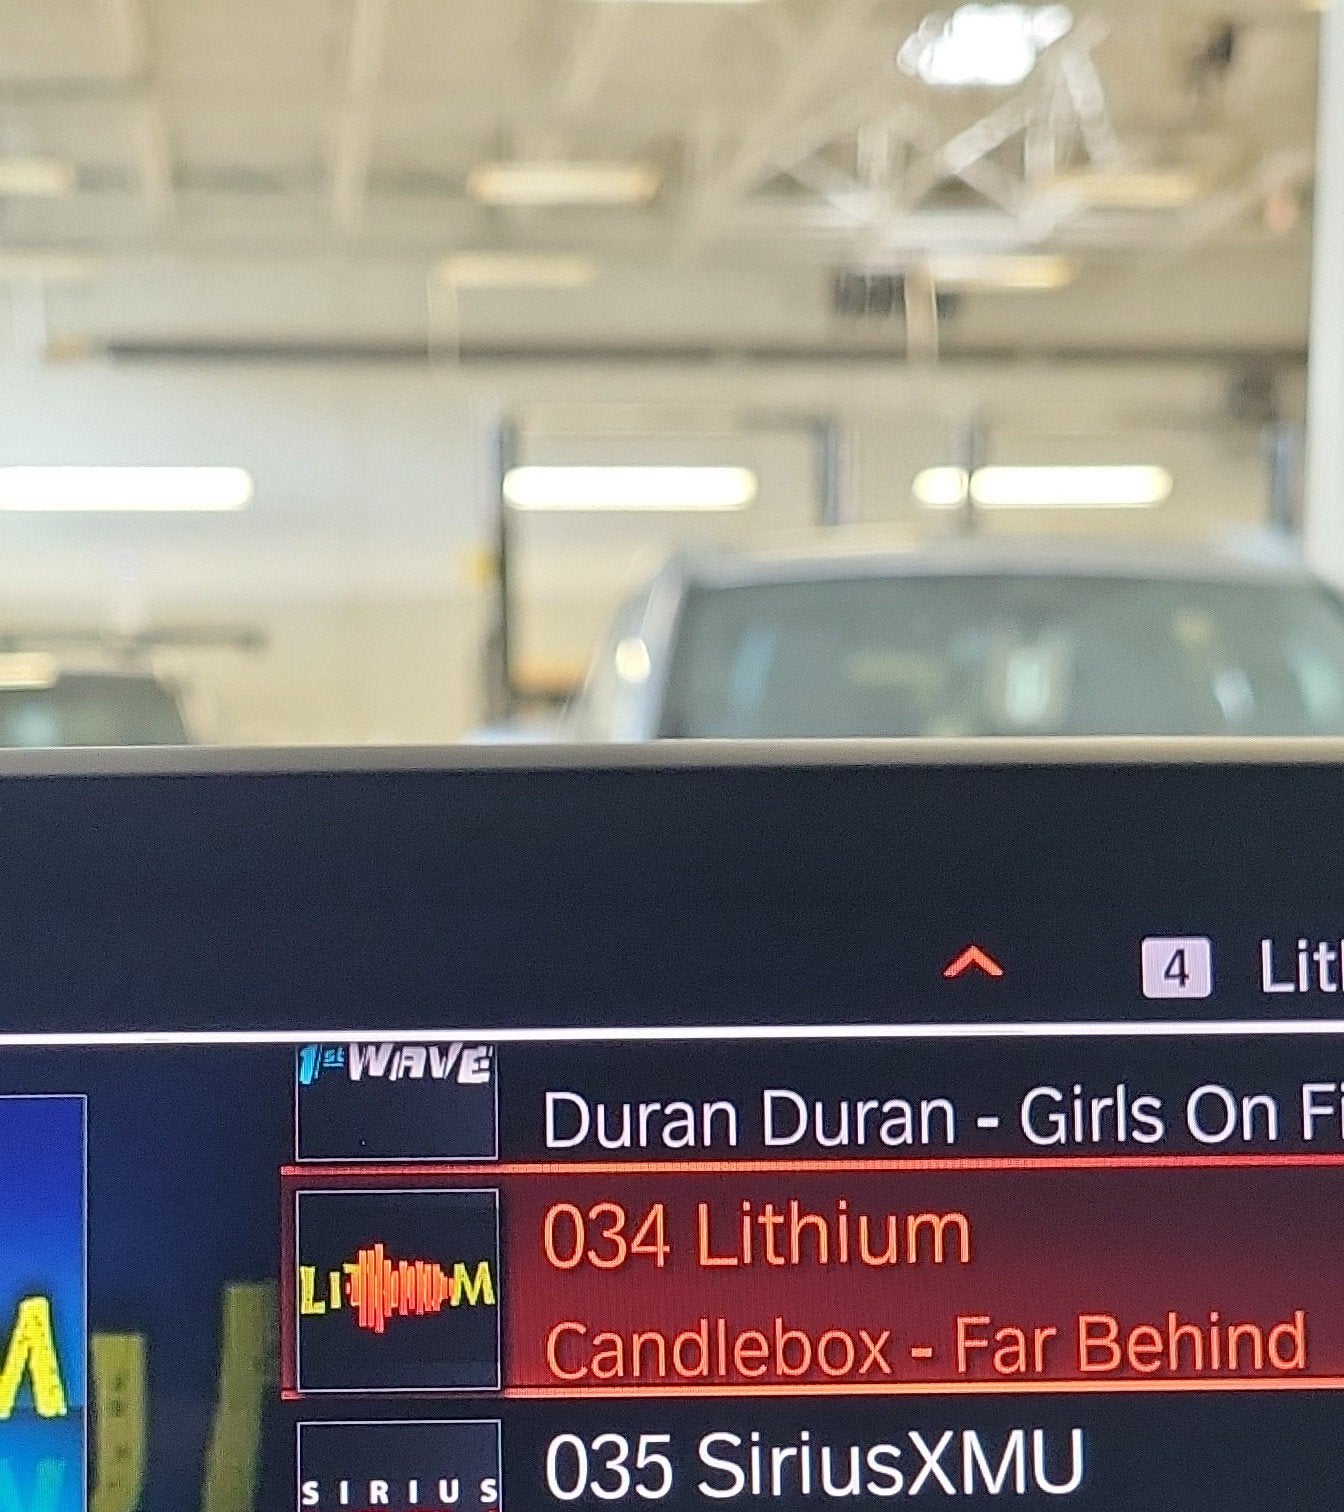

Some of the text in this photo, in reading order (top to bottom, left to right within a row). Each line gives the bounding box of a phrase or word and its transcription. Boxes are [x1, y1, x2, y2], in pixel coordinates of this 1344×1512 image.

[1156, 942, 1196, 990] 4
[544, 1090, 738, 1150] Duran
[762, 1088, 956, 1148] Duran
[976, 1116, 1000, 1129] -
[1020, 1083, 1165, 1146] Girls
[1186, 1083, 1278, 1145] On
[543, 1199, 971, 1271] 034 Lithium
[545, 1309, 1306, 1382] Candlebox - Far Behind
[301, 1477, 499, 1507] SIRIUS
[545, 1427, 1084, 1502] 035 SiriusXMU
